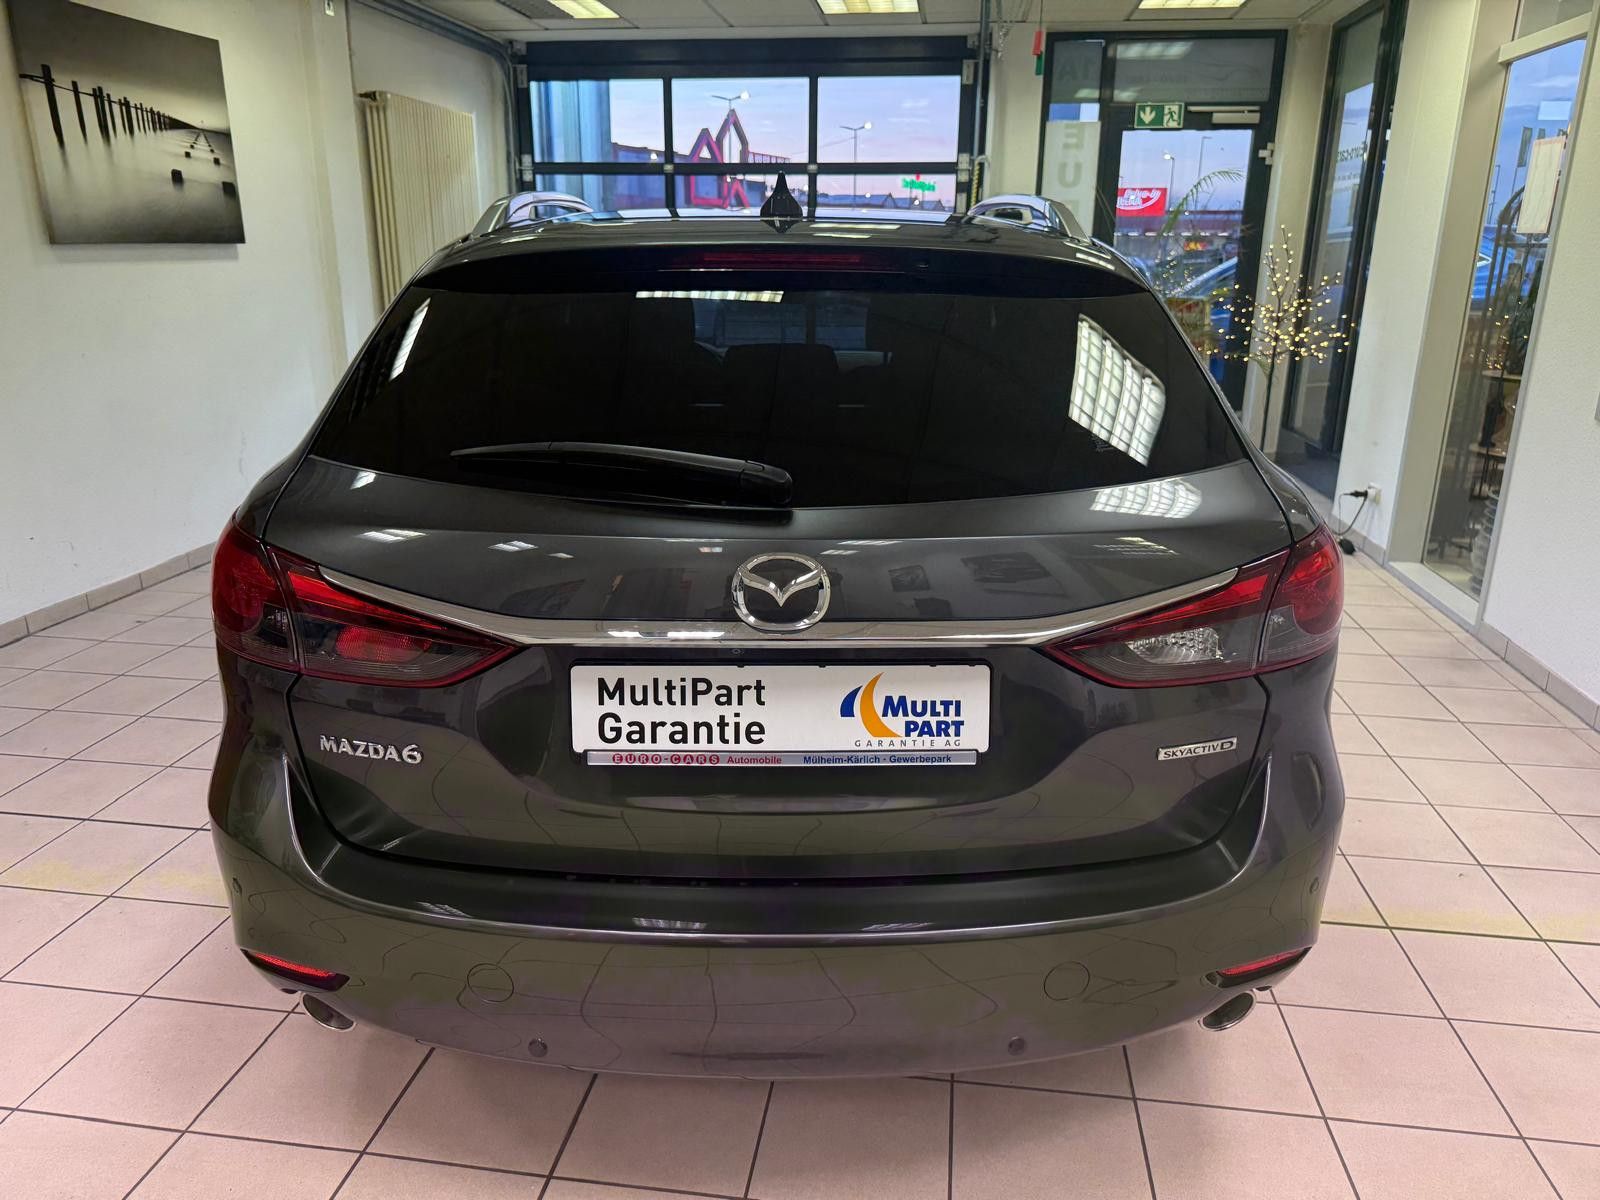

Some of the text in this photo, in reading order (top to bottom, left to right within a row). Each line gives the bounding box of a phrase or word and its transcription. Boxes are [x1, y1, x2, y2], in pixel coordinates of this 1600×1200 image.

[598, 677, 766, 706] MultiPart
[881, 695, 962, 717] MULTI
[598, 712, 766, 744] Garantie
[904, 720, 965, 737] PART
[854, 739, 961, 747] GARANTIE AG
[612, 753, 952, 766] EURO-CARS Automobile Mülheim-Kärlich Gewerbepark
